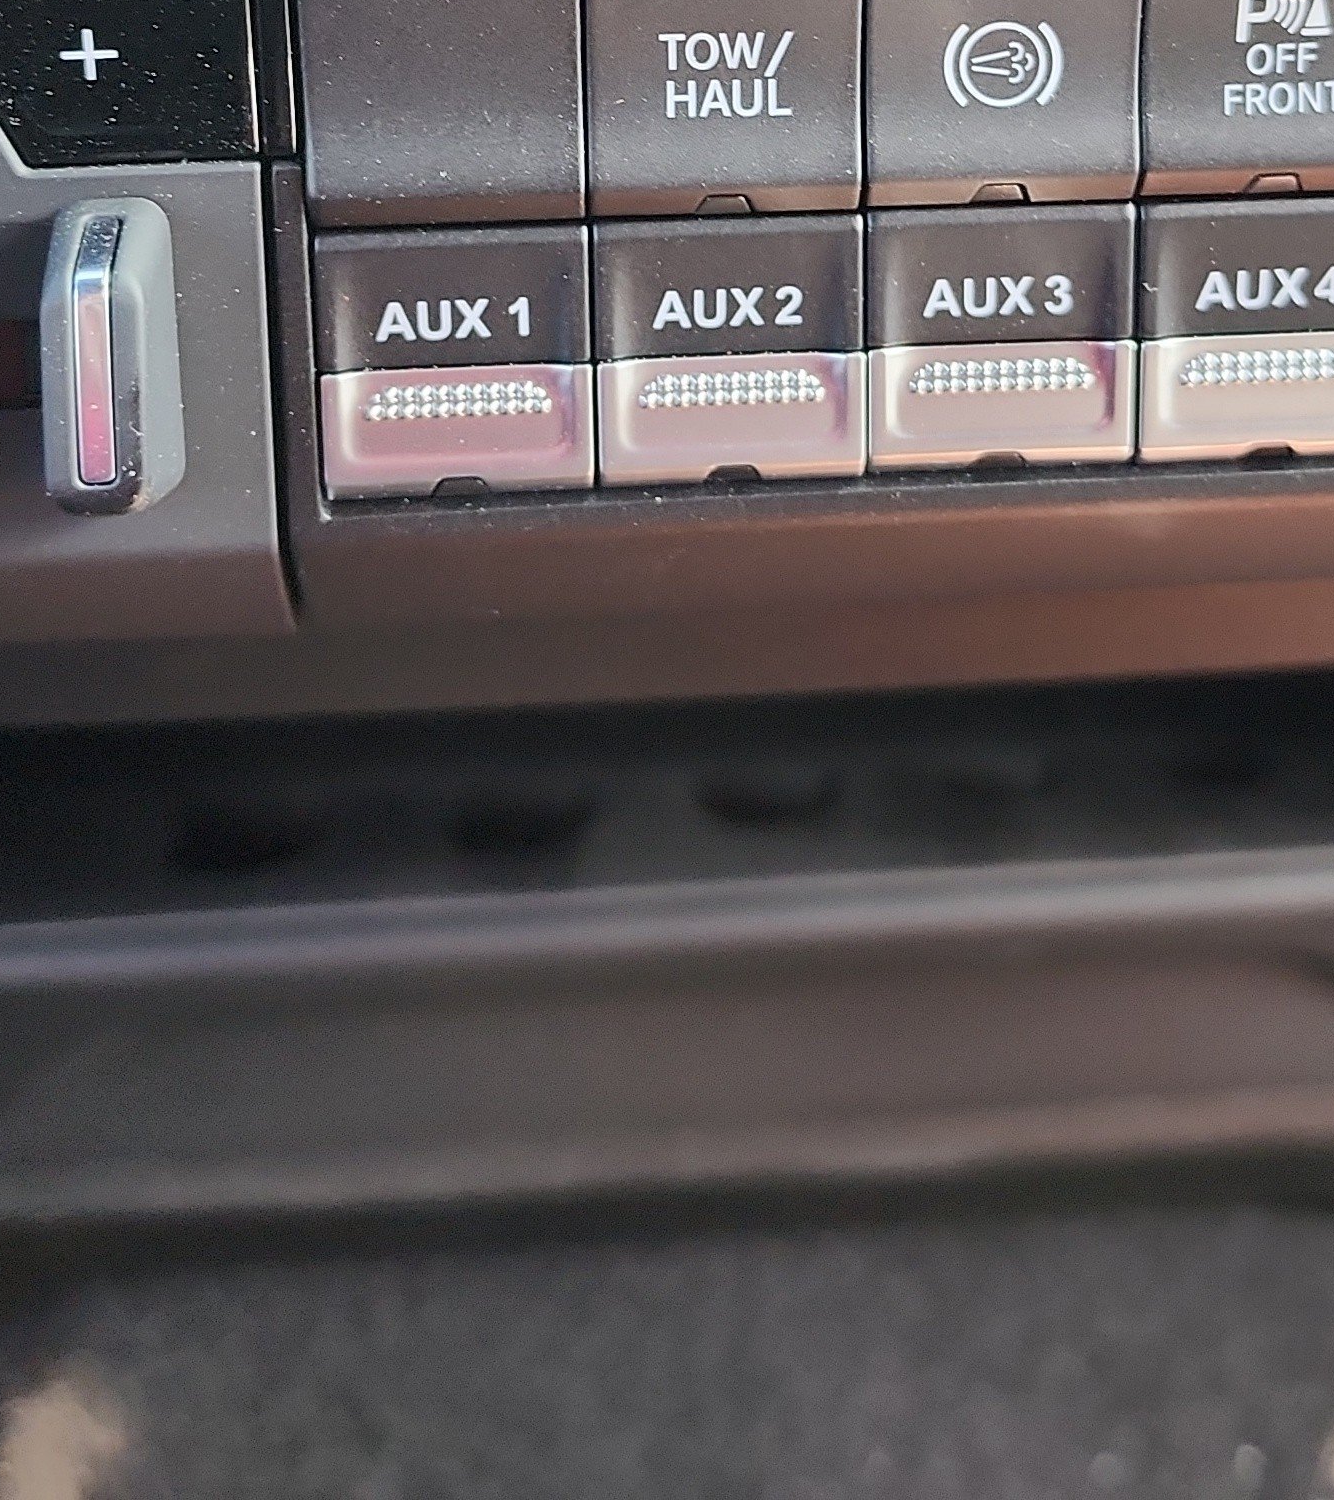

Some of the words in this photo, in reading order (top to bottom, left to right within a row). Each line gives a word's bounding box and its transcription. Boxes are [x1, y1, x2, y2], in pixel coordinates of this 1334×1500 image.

[658, 30, 795, 78] TOW/
[1246, 41, 1320, 76] OFF
[665, 78, 794, 119] HAUL
[652, 286, 765, 330] AUX
[774, 285, 803, 326] 2
[922, 275, 1035, 318] AUX
[1043, 274, 1074, 315] 3
[375, 298, 492, 343] AUX
[507, 296, 530, 337] 1
